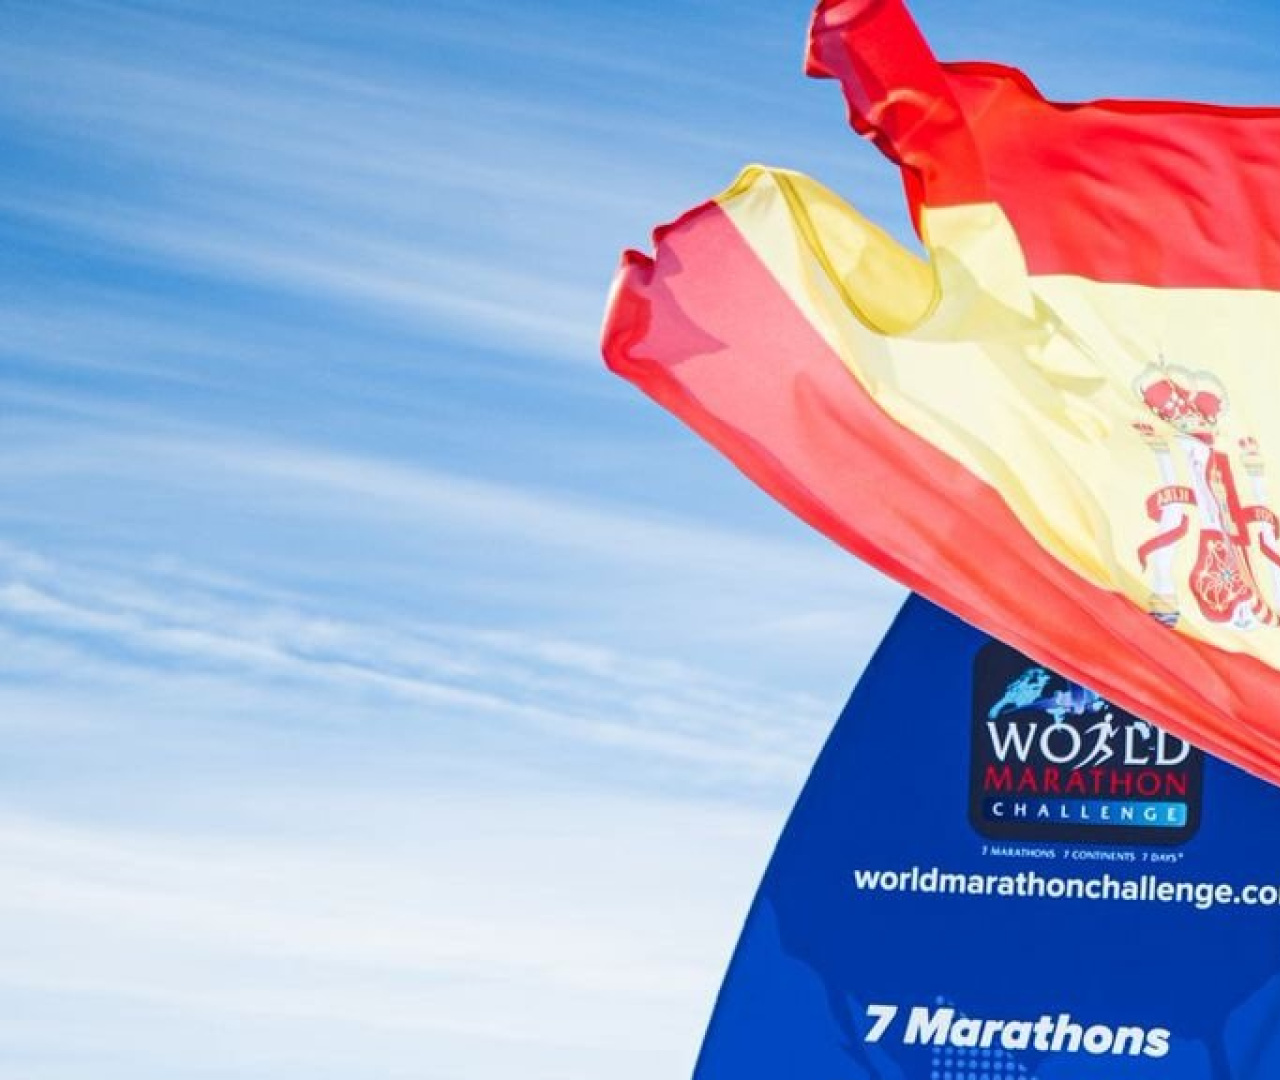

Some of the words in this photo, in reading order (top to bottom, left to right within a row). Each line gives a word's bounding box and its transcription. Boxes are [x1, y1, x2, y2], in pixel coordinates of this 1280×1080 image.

[984, 763, 1189, 796] MARATHON
[991, 801, 1177, 820] CHALLENGE
[991, 846, 1056, 858] MARATHONS
[1072, 850, 1136, 862] CONTINENTS
[864, 1004, 898, 1043] 7
[904, 1005, 1171, 1058] Marathons
